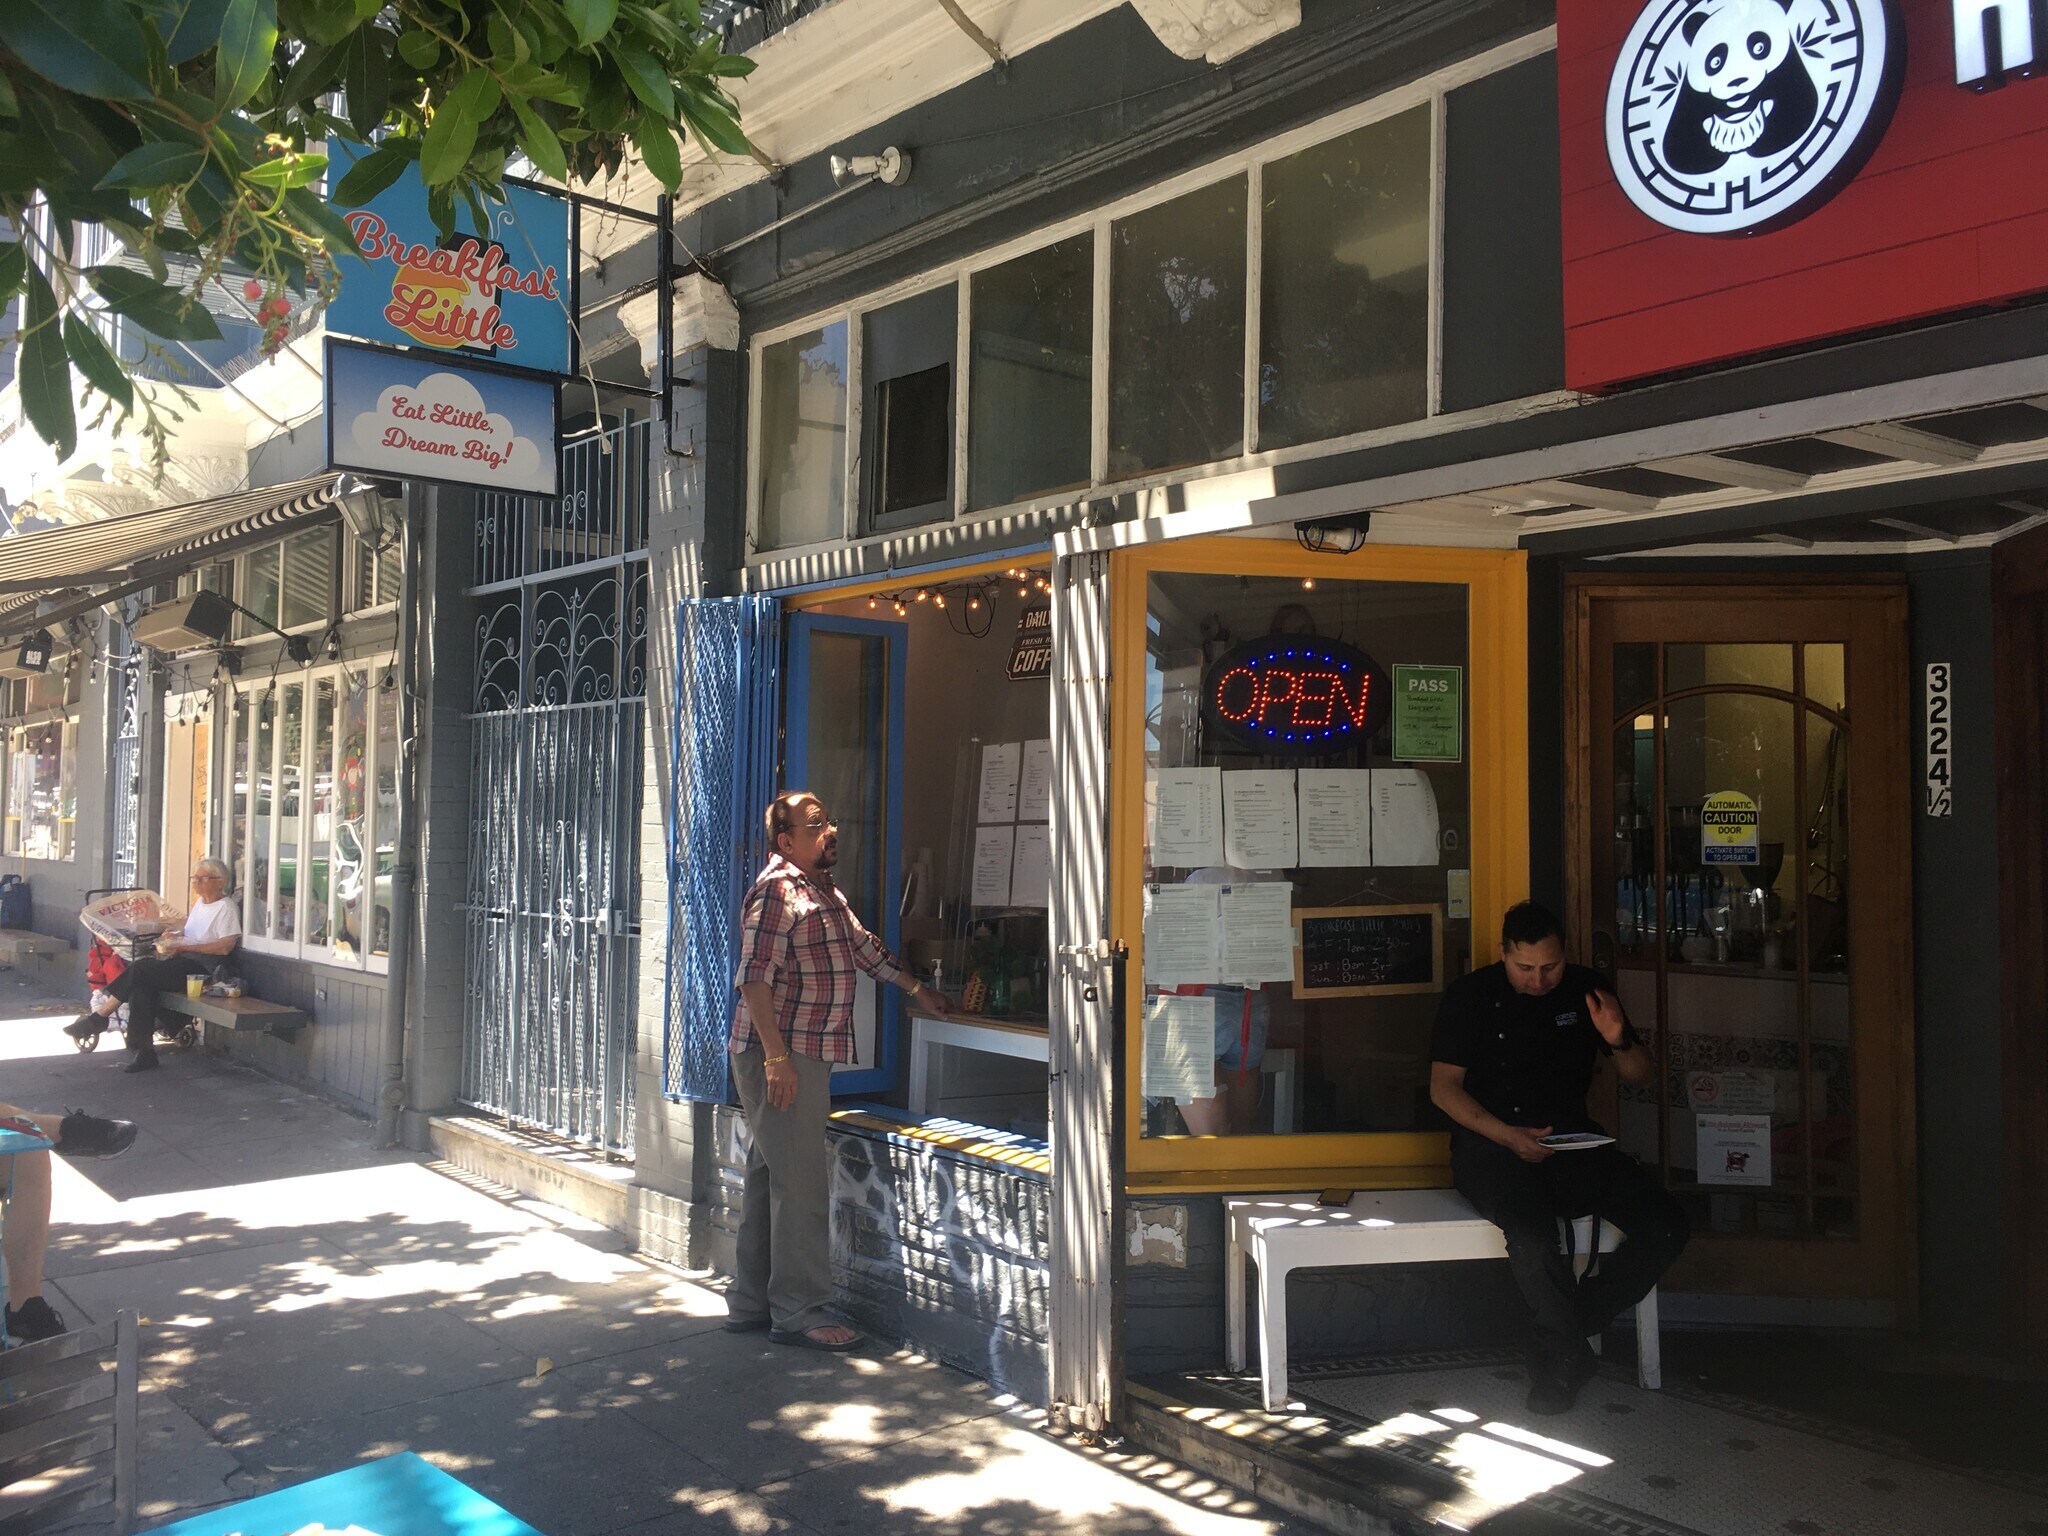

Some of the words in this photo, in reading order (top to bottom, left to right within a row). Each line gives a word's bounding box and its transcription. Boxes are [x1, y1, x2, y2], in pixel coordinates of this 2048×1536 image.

[343, 211, 559, 300] Breakfast
[384, 283, 518, 349] Little
[391, 395, 426, 420] Eat
[429, 402, 494, 434] Little,
[381, 426, 458, 457] Dream
[462, 439, 514, 470] Big!
[1021, 637, 1043, 647] FRESH
[1217, 667, 1371, 727] OPEN
[1408, 679, 1449, 692] PASS
[1704, 812, 1755, 823] CAUTION
[1707, 801, 1752, 809] AUTOMATIC
[1718, 826, 1742, 834] DOOR
